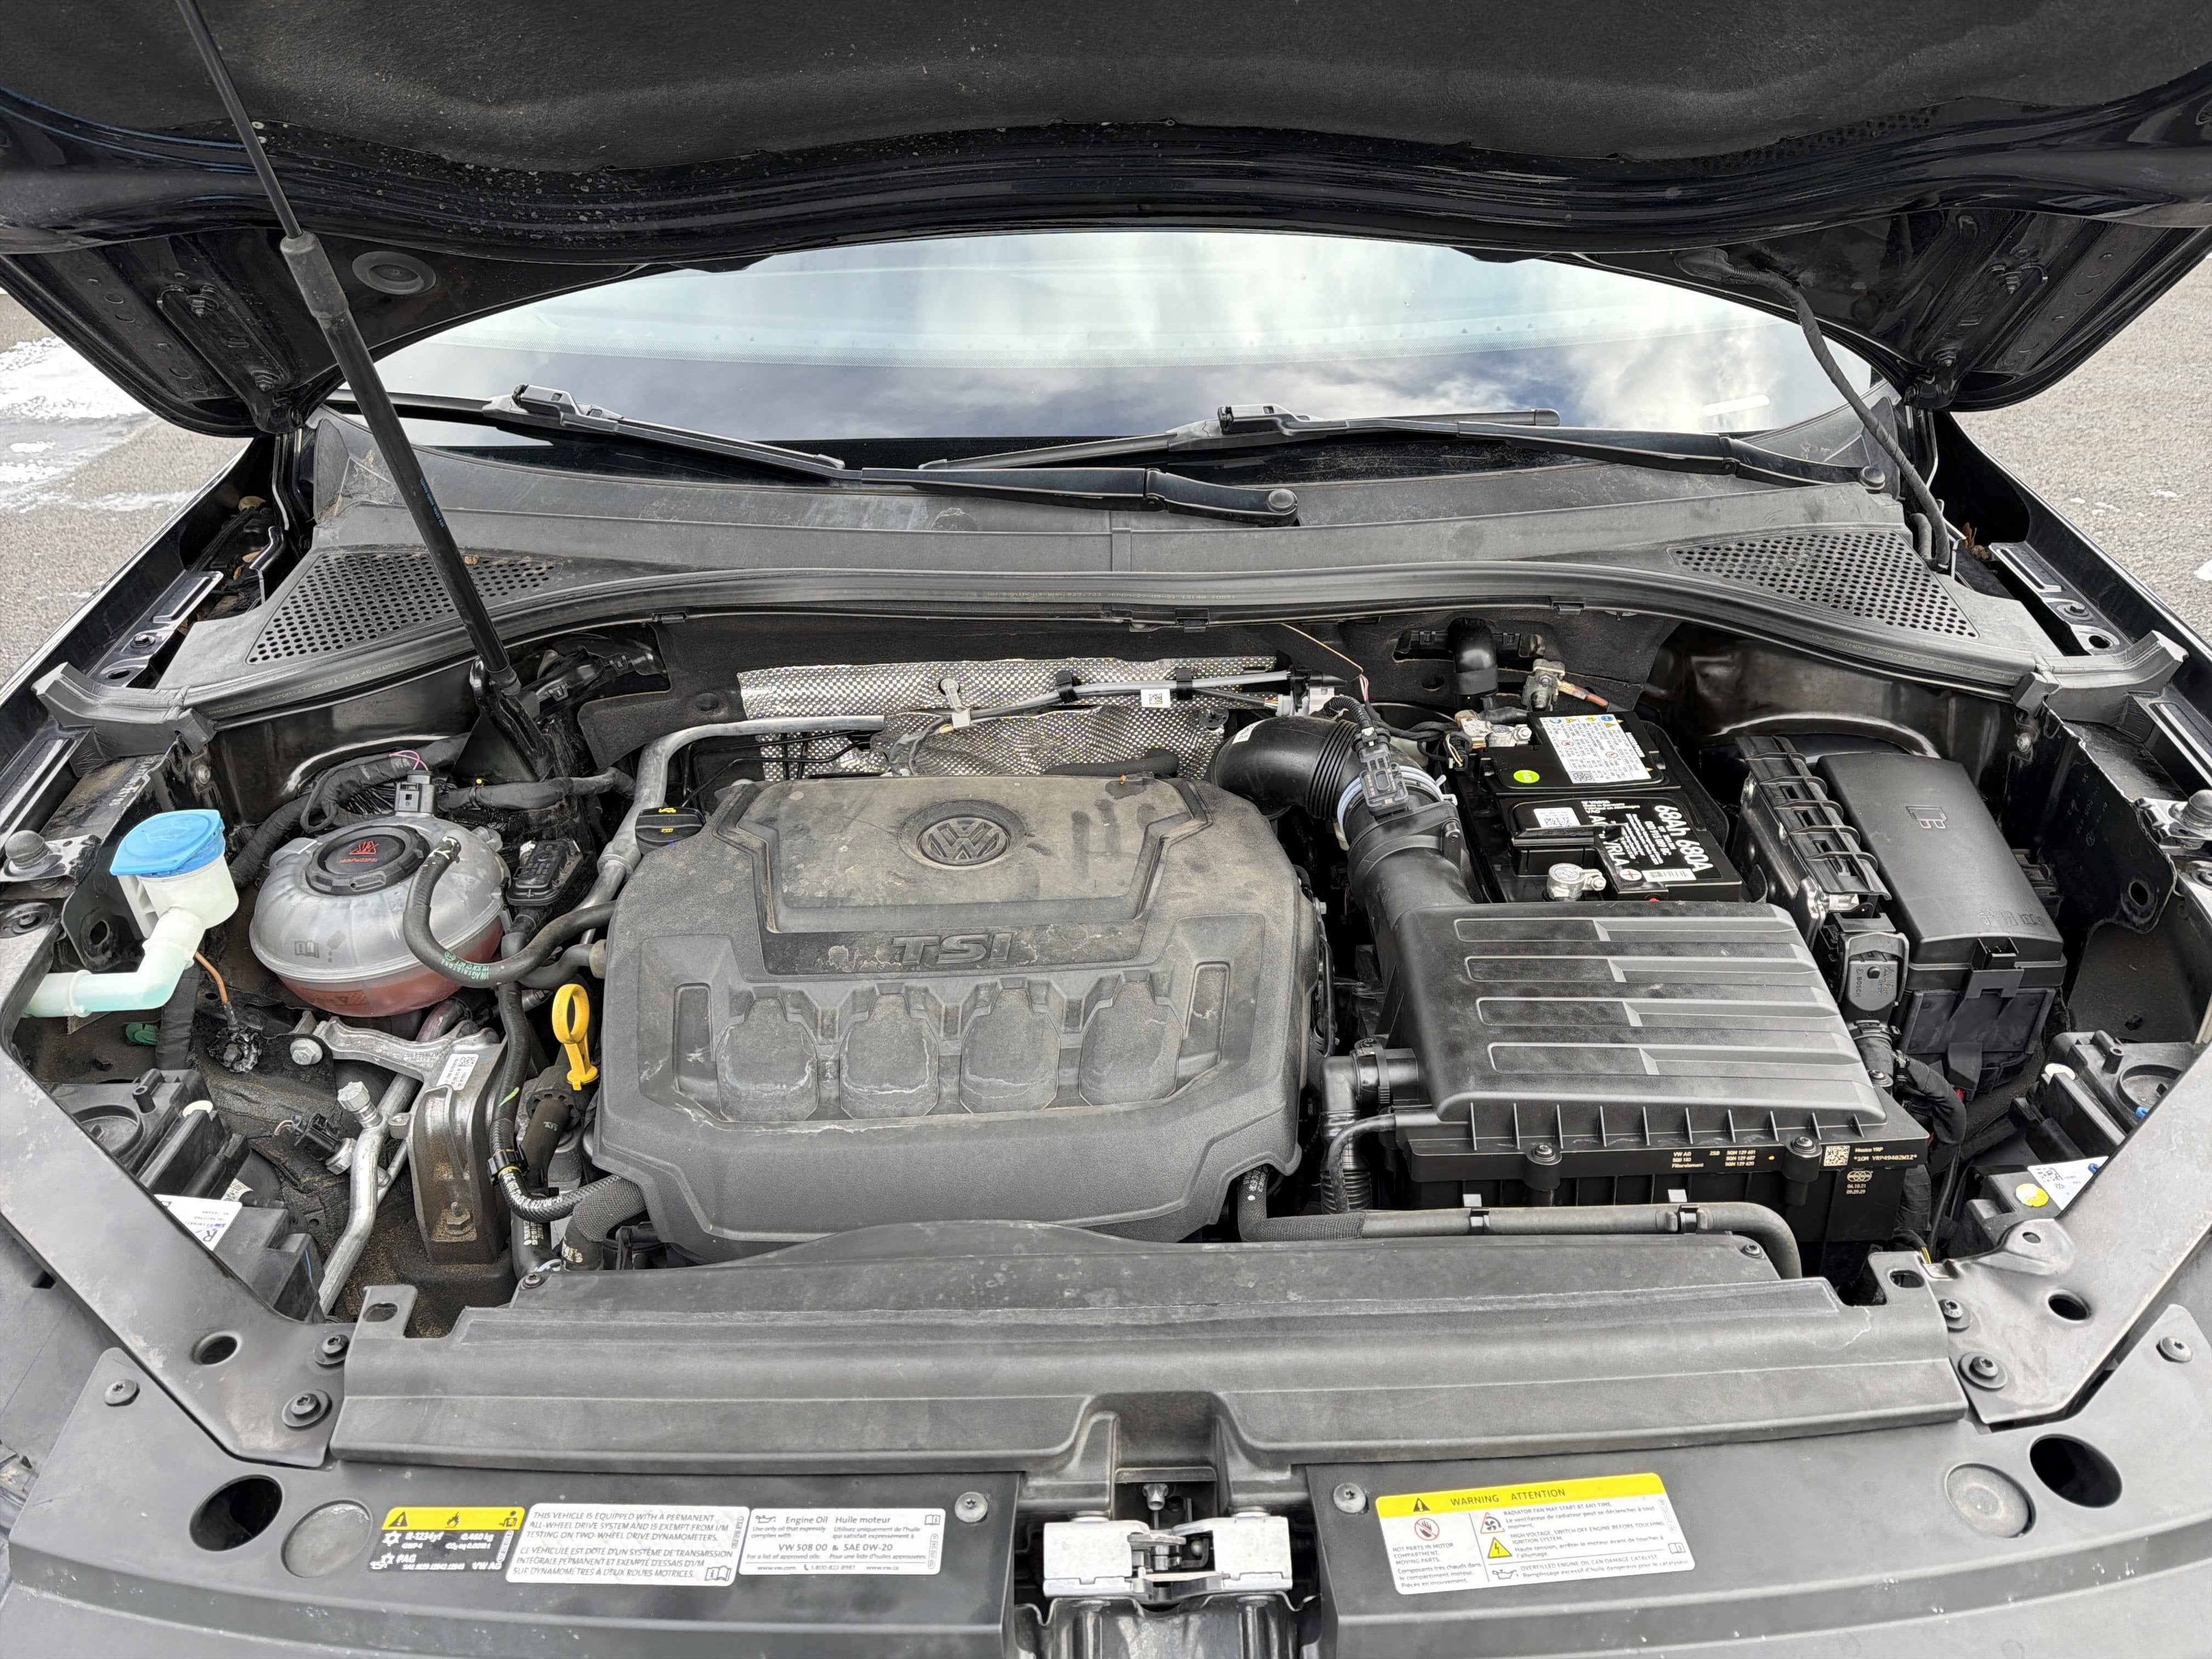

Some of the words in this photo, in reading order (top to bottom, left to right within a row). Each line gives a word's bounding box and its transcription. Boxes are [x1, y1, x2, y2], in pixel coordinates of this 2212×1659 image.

[1654, 805, 1691, 837] 68Ah
[1675, 839, 1714, 872] 680A
[892, 933, 1013, 966] TSI
[440, 958, 472, 976] TRISTONE
[1449, 1494, 1500, 1506] WARNING
[1511, 1488, 1566, 1501] ATTENTION
[785, 1516, 814, 1526] Engine
[575, 1531, 623, 1539] TWO-WHEEL
[651, 1533, 719, 1541] DYNAMOMETERS.
[796, 1543, 813, 1551] 508
[815, 1543, 828, 1551] 00
[843, 1543, 860, 1551] SAE
[862, 1543, 893, 1551] 0W-20
[396, 1554, 417, 1564] PAG
[676, 1550, 733, 1558] TRANSMISSION
[472, 1561, 488, 1570] VW
[487, 1561, 502, 1570] AG
[1520, 1564, 1556, 1572] OVERFILLED
[603, 1568, 624, 1577] DEUX
